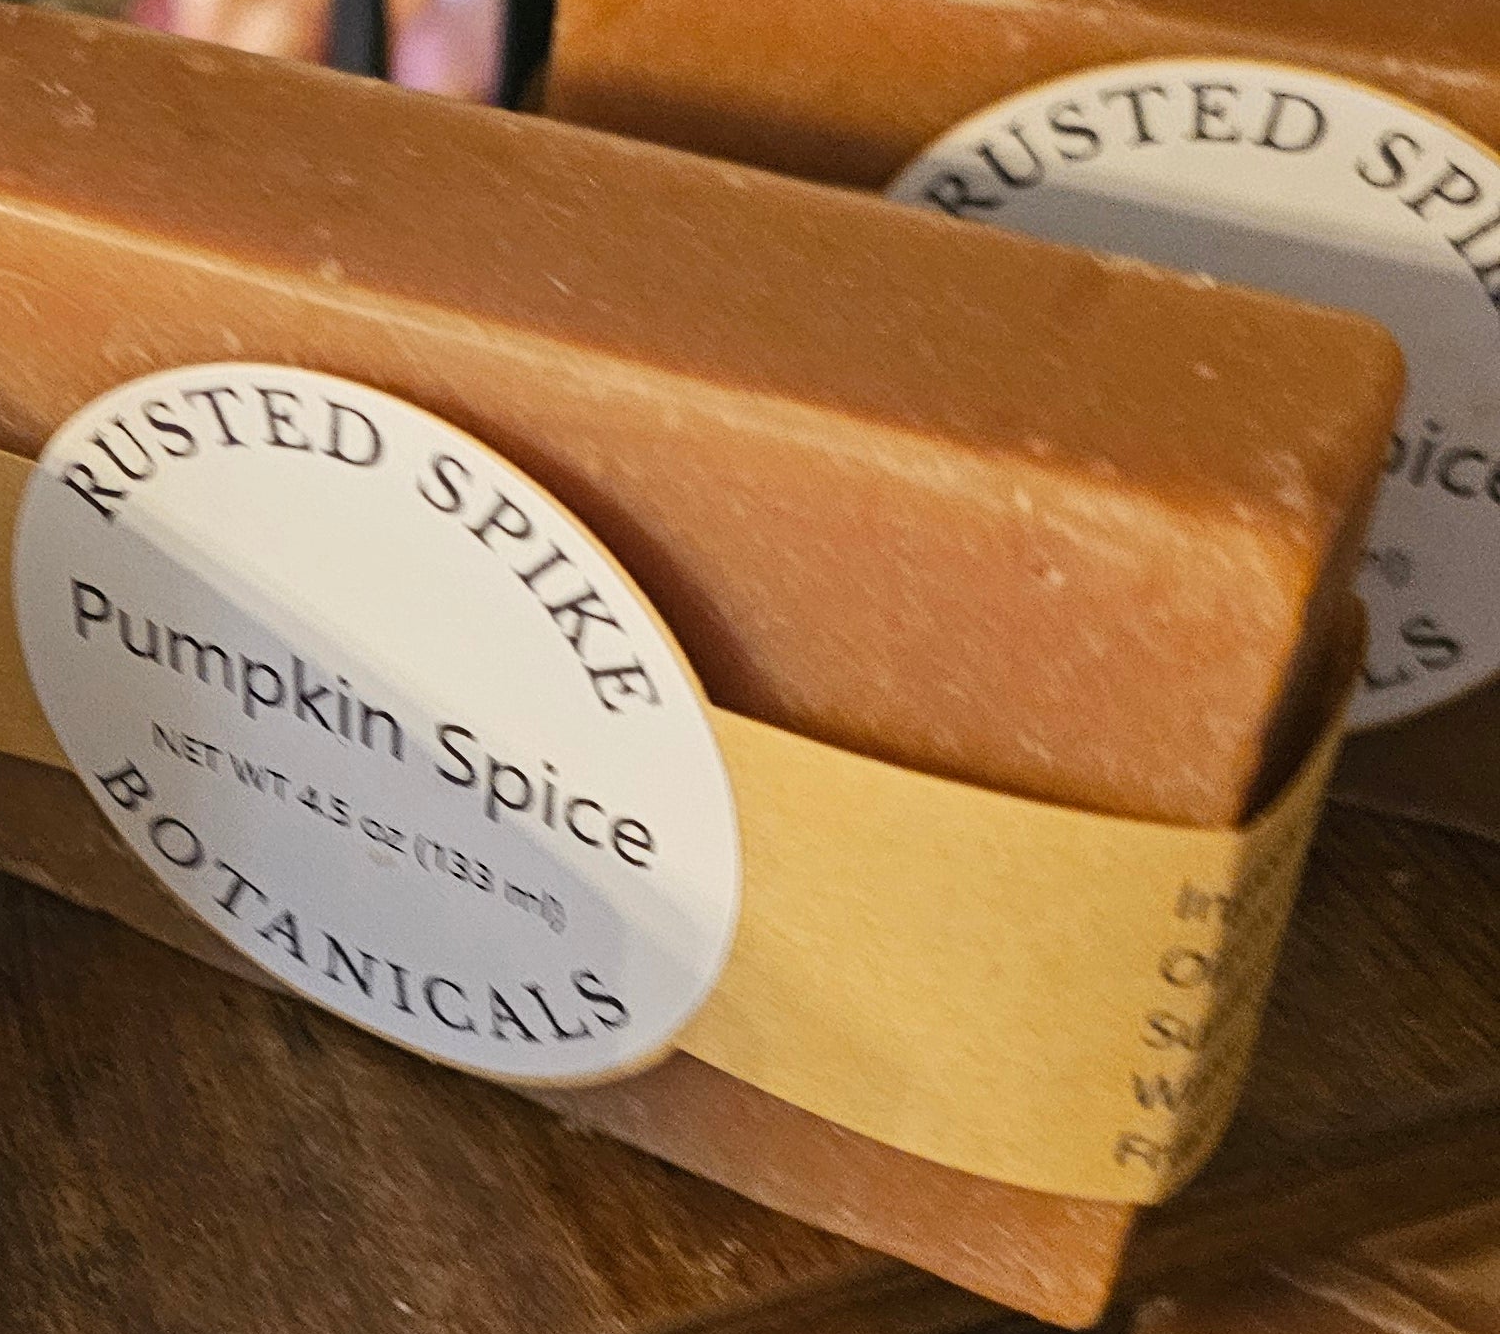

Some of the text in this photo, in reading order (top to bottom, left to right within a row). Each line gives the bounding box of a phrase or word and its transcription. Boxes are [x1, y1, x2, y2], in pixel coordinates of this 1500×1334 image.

[926, 80, 1330, 218] RUSTED
[61, 383, 662, 717] RUSTED SPIKE
[70, 576, 658, 871] Pumpkin Spice
[151, 721, 224, 773] NET
[227, 750, 293, 802] WT
[358, 813, 408, 855] oz
[412, 832, 496, 896] (133
[94, 758, 634, 1046] BOTANICALS
